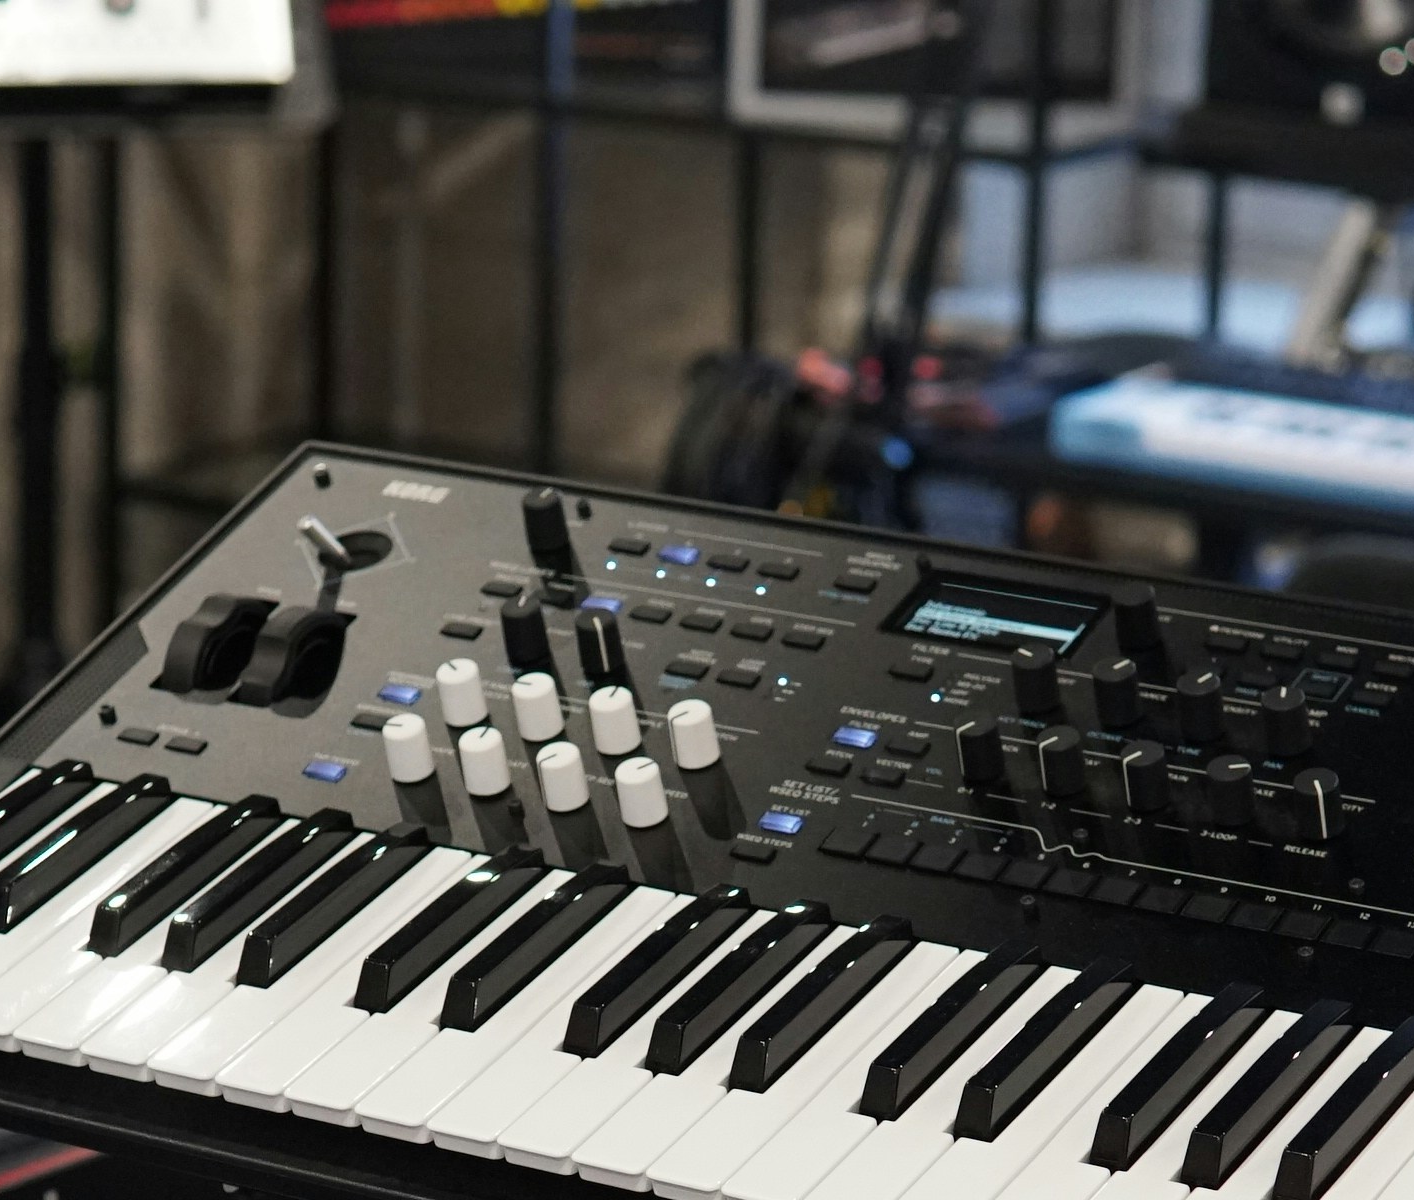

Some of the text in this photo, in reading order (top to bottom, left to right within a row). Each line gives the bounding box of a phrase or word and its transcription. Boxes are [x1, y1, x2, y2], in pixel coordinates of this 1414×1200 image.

[1364, 681, 1398, 693] ENTER
[840, 705, 908, 724] ENVELOPES
[825, 749, 854, 760] PITCH
[876, 758, 912, 770] VECTOR
[782, 779, 802, 790] SET
[802, 791, 840, 805] STEPS
[764, 835, 793, 848] STEPS
[1199, 829, 1238, 842] 3-LOOP
[1284, 844, 1328, 858] RELEASE
[1359, 912, 1370, 920] 12
